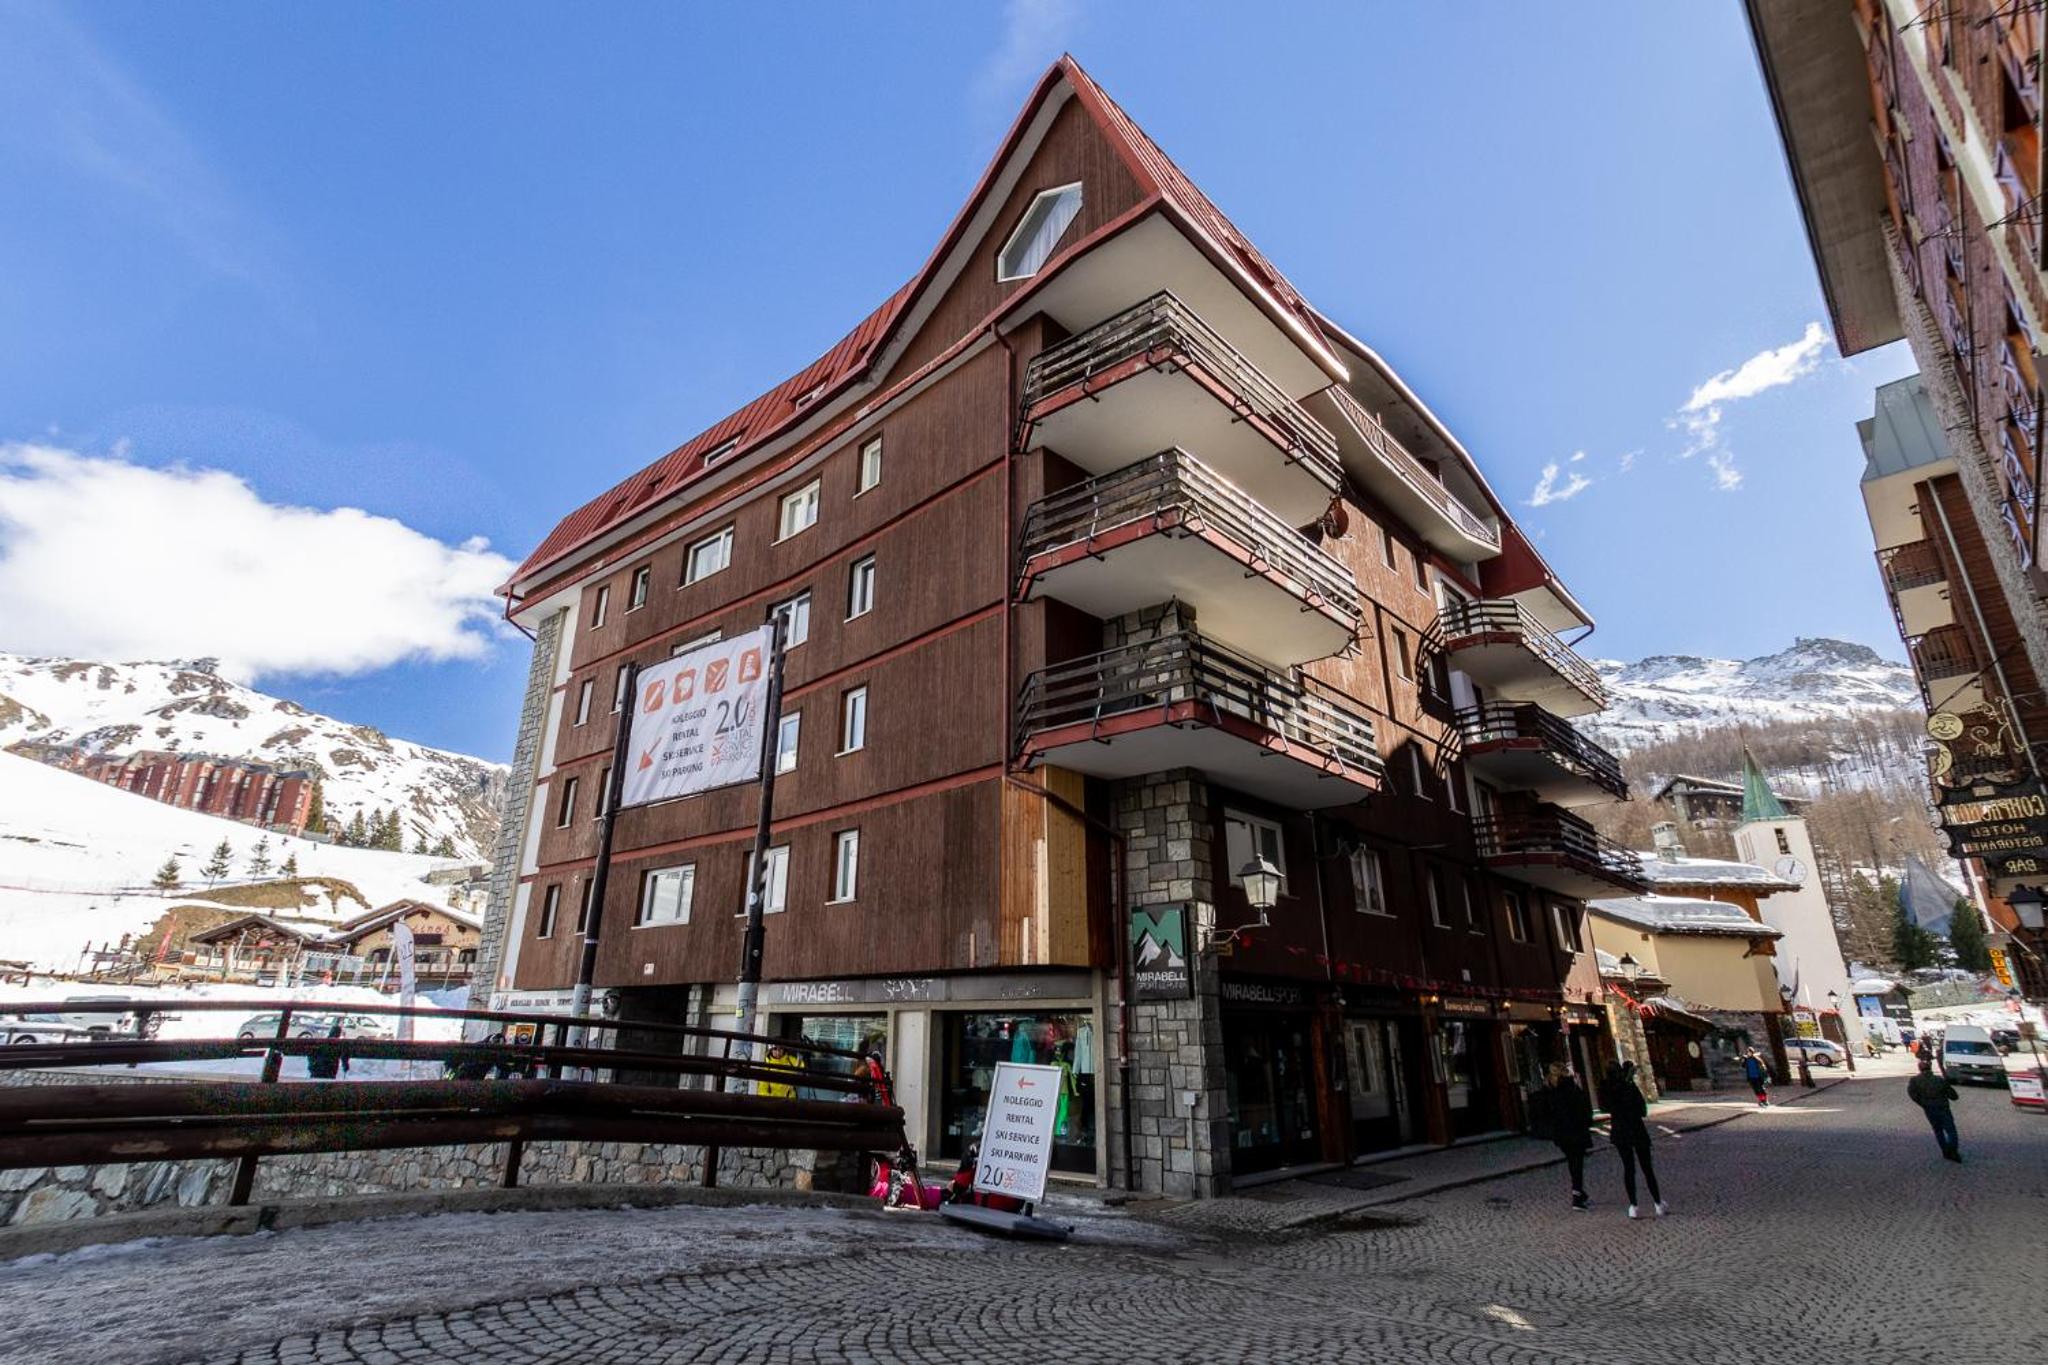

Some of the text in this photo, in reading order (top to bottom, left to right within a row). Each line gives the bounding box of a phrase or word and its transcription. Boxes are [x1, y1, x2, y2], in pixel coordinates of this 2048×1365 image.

[1136, 971, 1187, 982] MIRABELL
[783, 982, 854, 1002] MIRABELL
[1221, 982, 1275, 1002] MIRABELL
[1003, 1095, 1043, 1108] NOLEGGIO
[1006, 1113, 1034, 1126] RENTAL
[995, 1130, 1041, 1145] SKI SERVICE
[990, 1147, 1039, 1164] SKI PARKING
[981, 1164, 1004, 1186] 2.0
